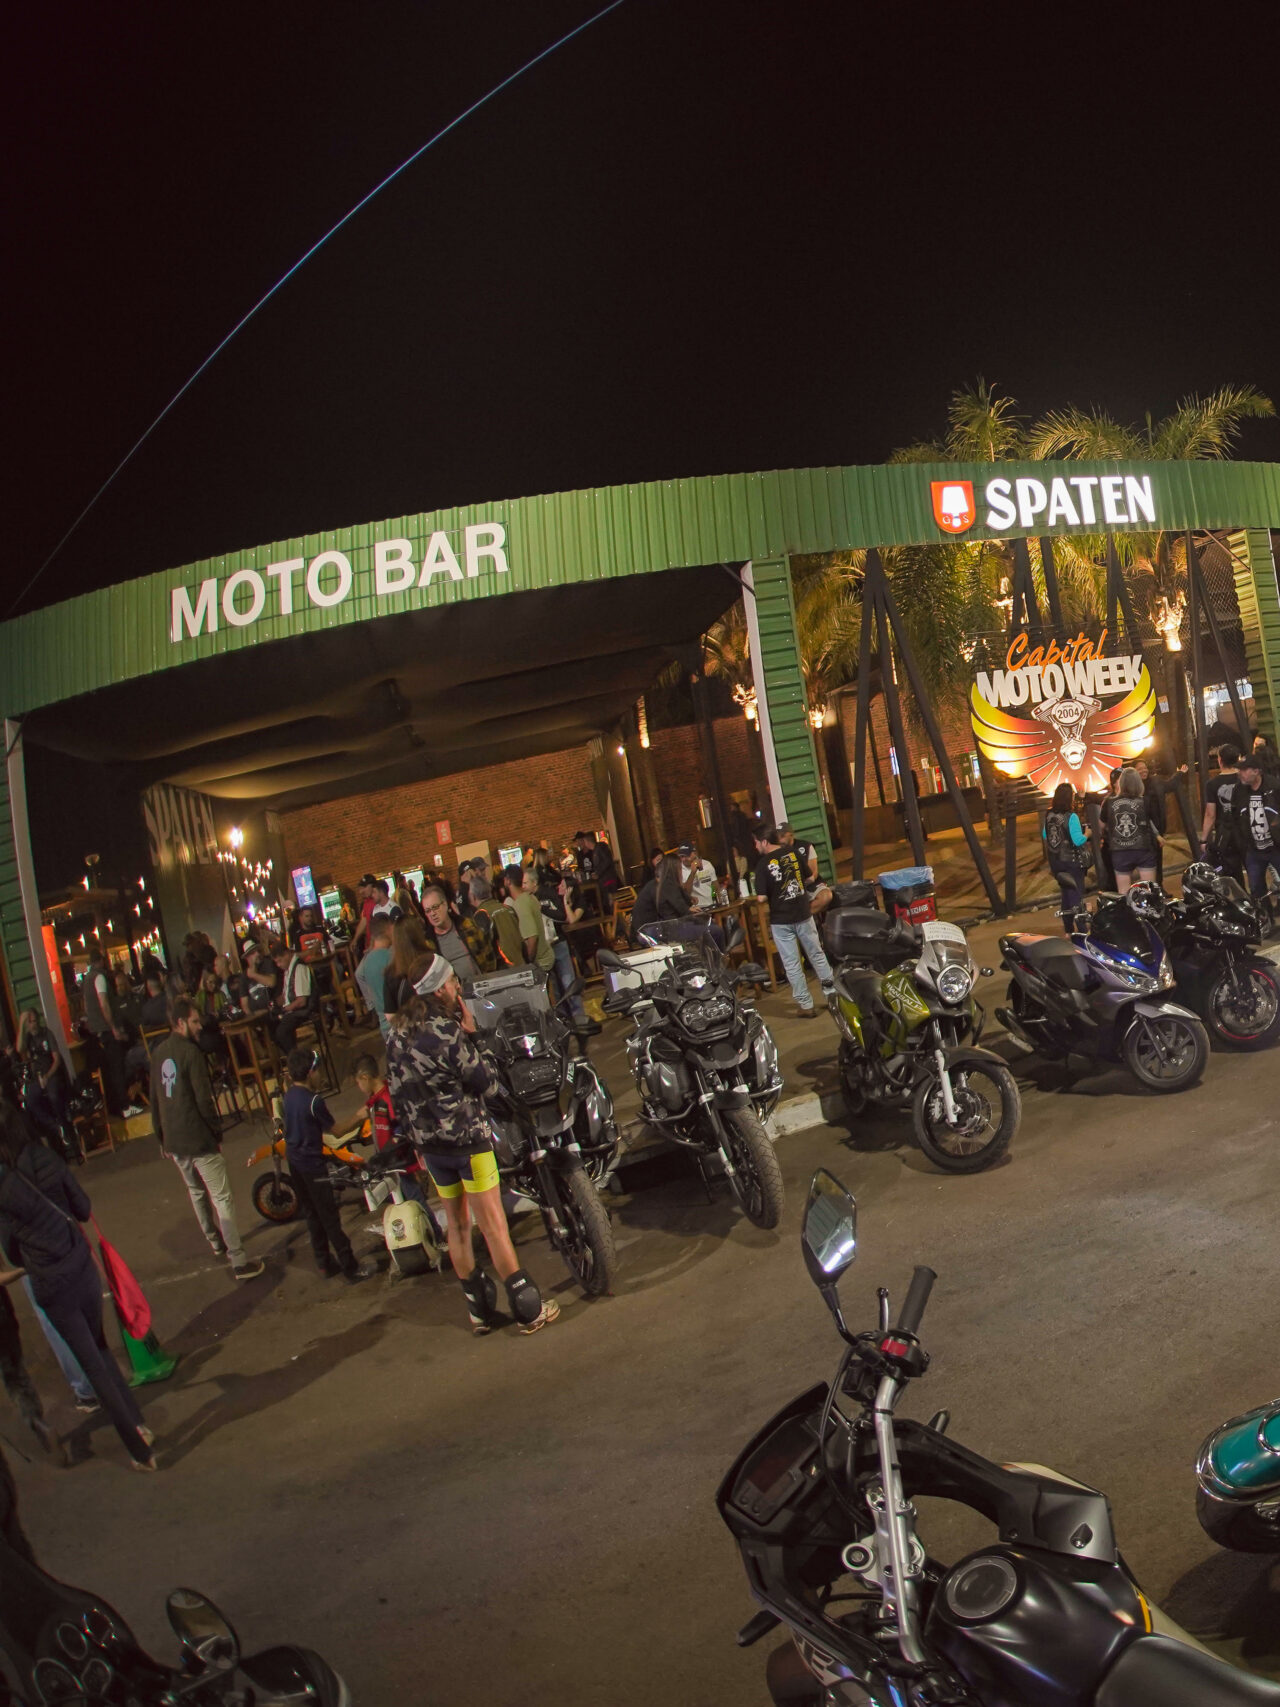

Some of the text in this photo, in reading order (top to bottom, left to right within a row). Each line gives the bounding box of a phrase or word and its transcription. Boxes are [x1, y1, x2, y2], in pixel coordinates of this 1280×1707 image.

[985, 475, 1157, 531] SPATEN
[170, 522, 510, 643] MOTO BAR
[1006, 628, 1108, 679] Capital
[1057, 707, 1080, 719] 2004
